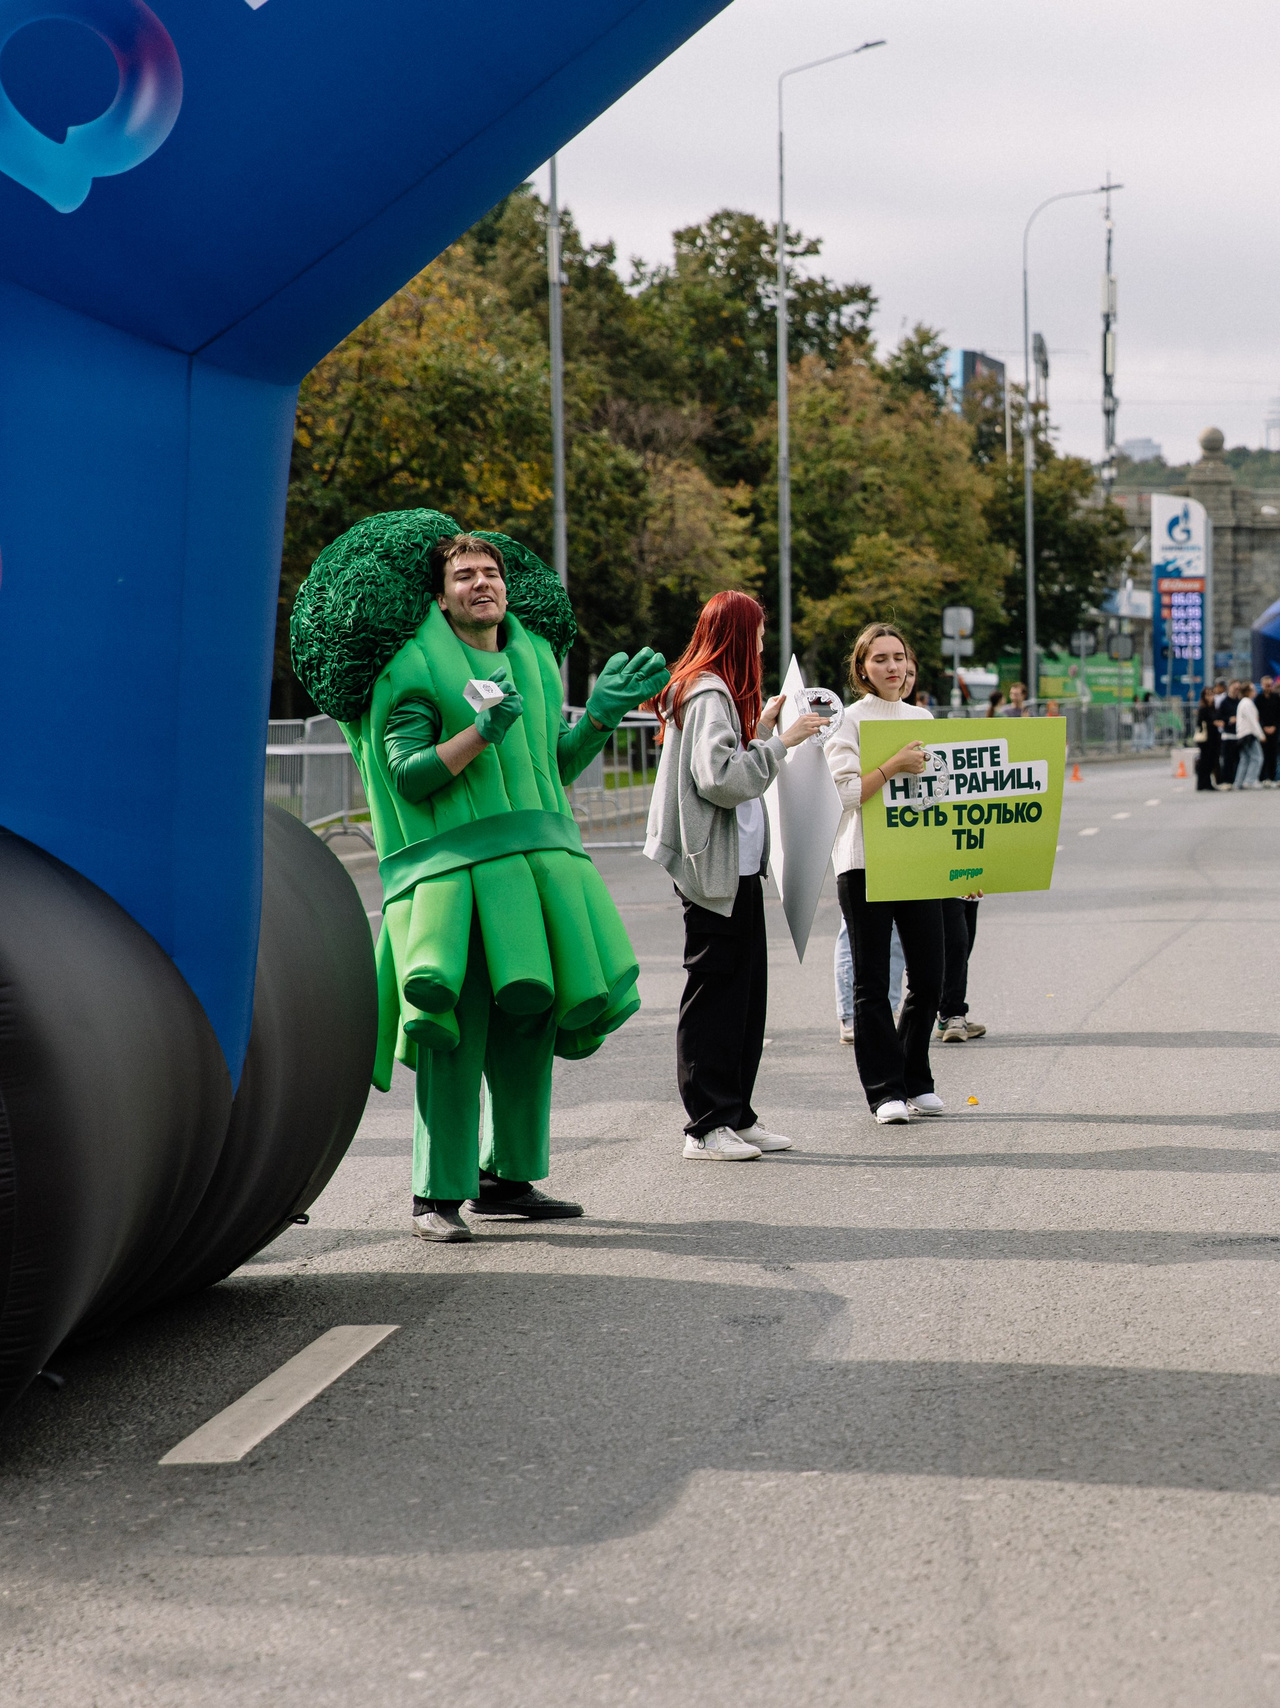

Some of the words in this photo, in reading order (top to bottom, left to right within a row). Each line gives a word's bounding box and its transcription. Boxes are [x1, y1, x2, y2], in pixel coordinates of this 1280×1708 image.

[952, 745, 1001, 771] БЕГЕ
[886, 804, 948, 828] ЕСТЬ
[952, 801, 1043, 826] ТОЛЬКО
[952, 828, 985, 850] ТЫ
